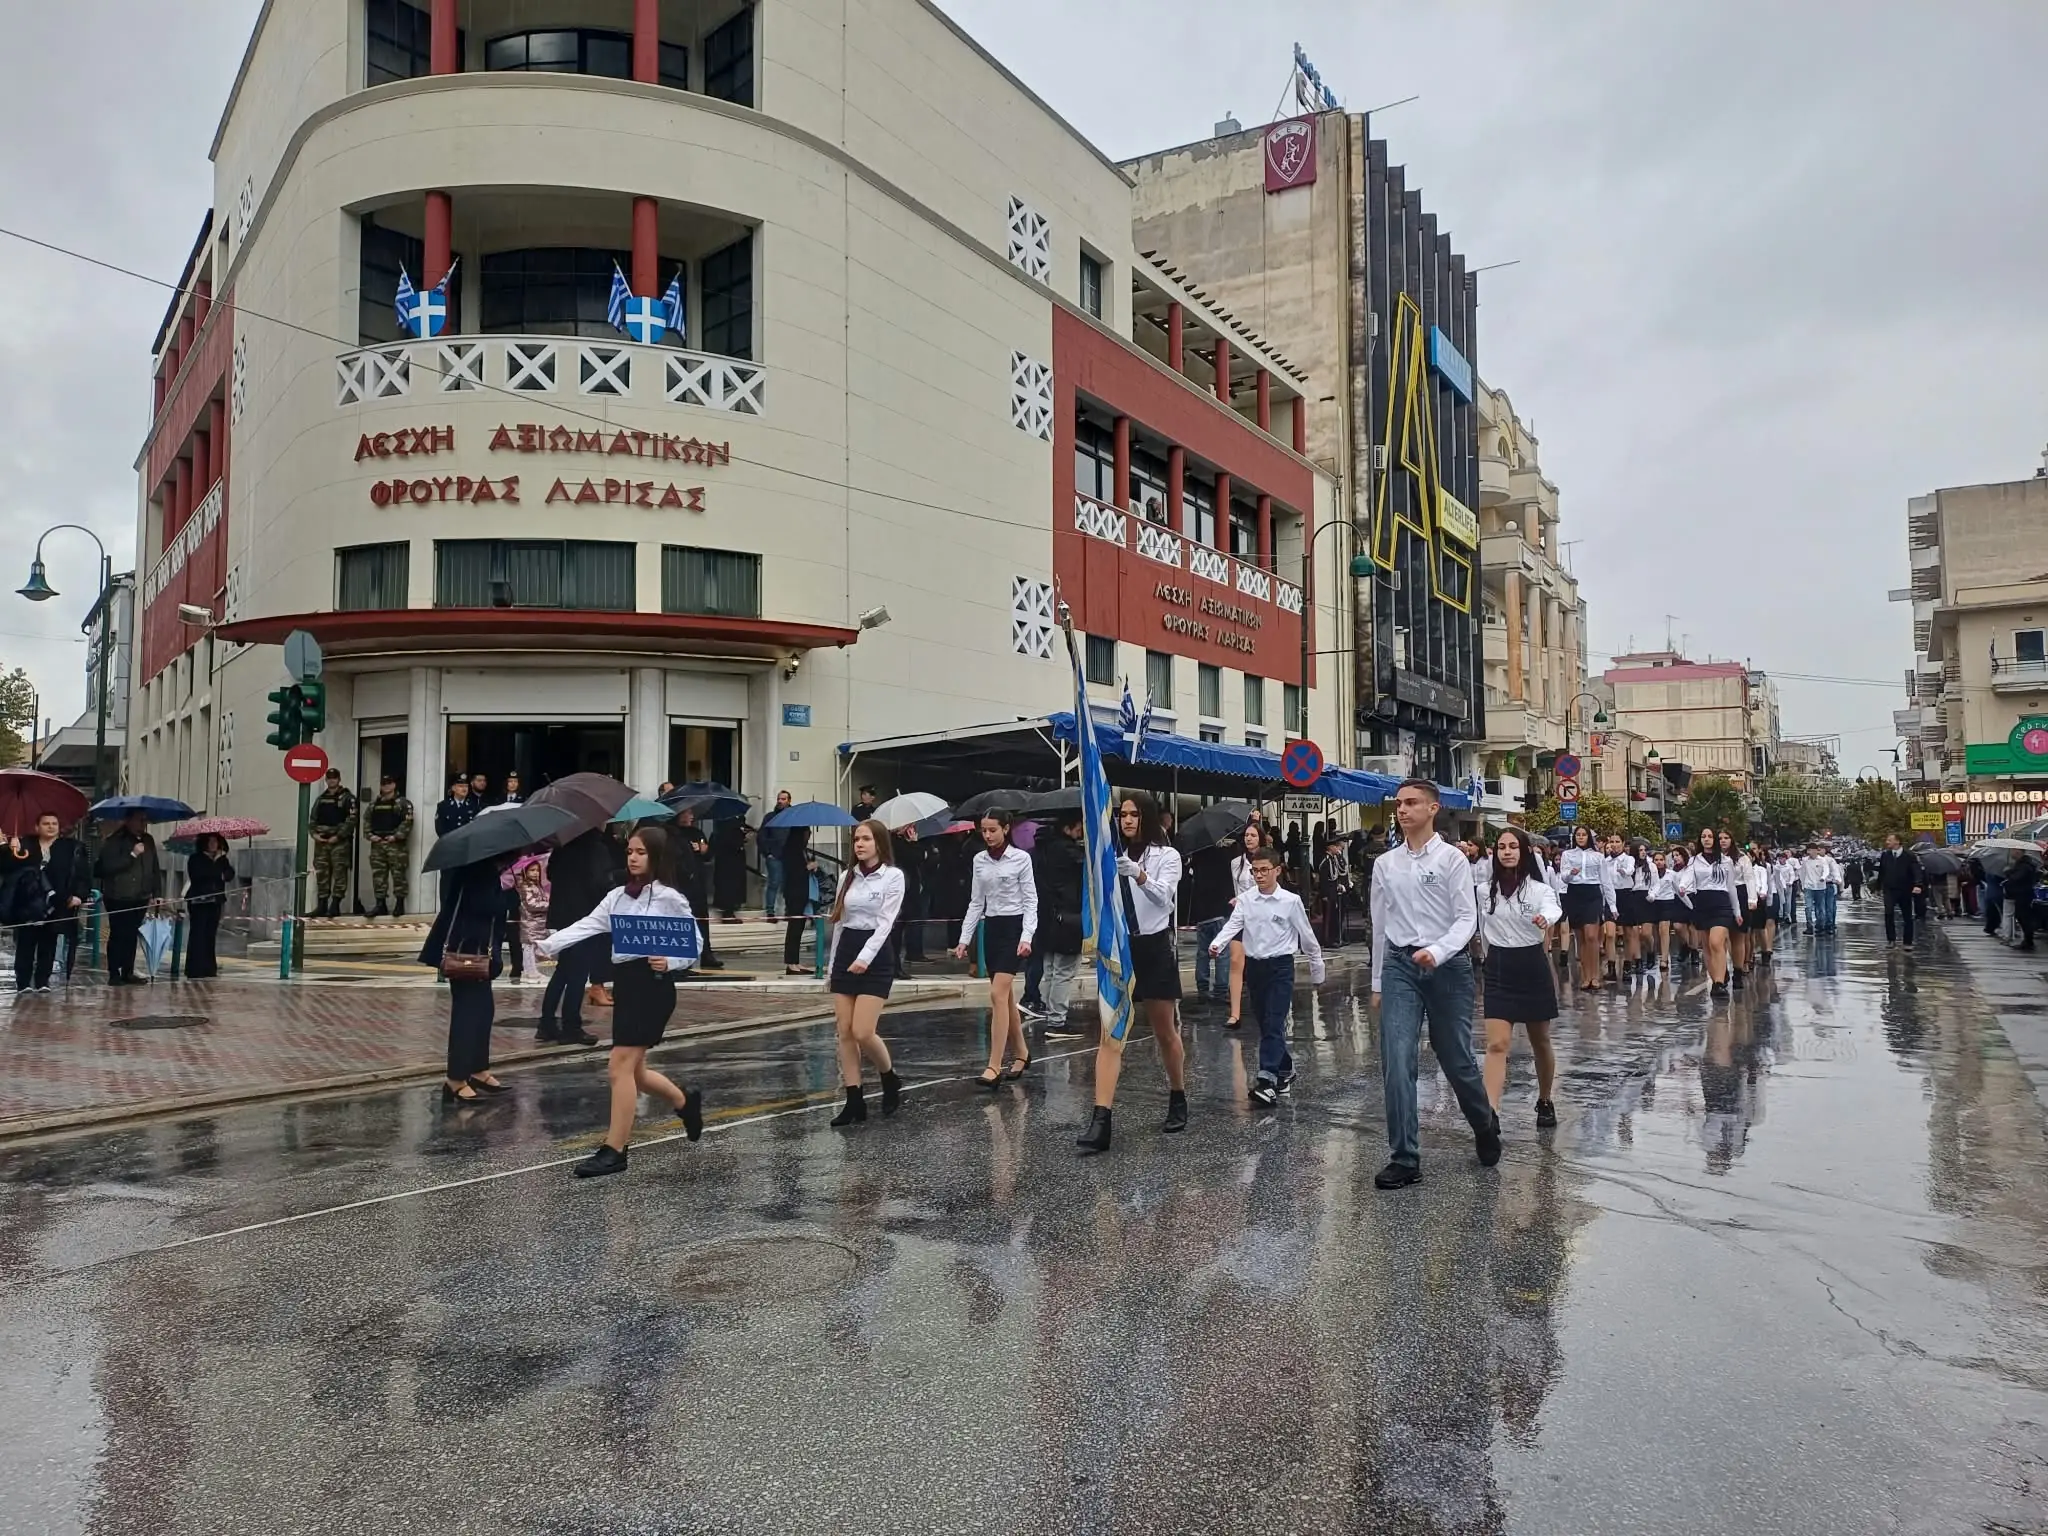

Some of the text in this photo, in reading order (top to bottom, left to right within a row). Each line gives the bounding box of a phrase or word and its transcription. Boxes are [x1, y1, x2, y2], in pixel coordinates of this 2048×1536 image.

[354, 423, 730, 467] ΛΕΣΧΗ ΑΞΙΩΜΑΤΙΚΩΝ
[370, 475, 706, 512] ΦΡΟΥΡΑΣ ΛΑΡΙΣΑΣ
[1444, 497, 1474, 534] ALTERLIFE
[1155, 581, 1261, 629] ΛΕΣΧΗ ΑΞΙΩΜΑΤΙΚΩΝ
[1163, 613, 1256, 654] ΦΡΟΥΡΑΣ ΛΑΡΙΣΑΣ
[1930, 791, 2048, 802] BOULANGE
[614, 918, 691, 932] 10ο ΓΥΜΝΑΣΙΟ
[621, 935, 690, 947] ΛΑΡΙΣΑΣ
